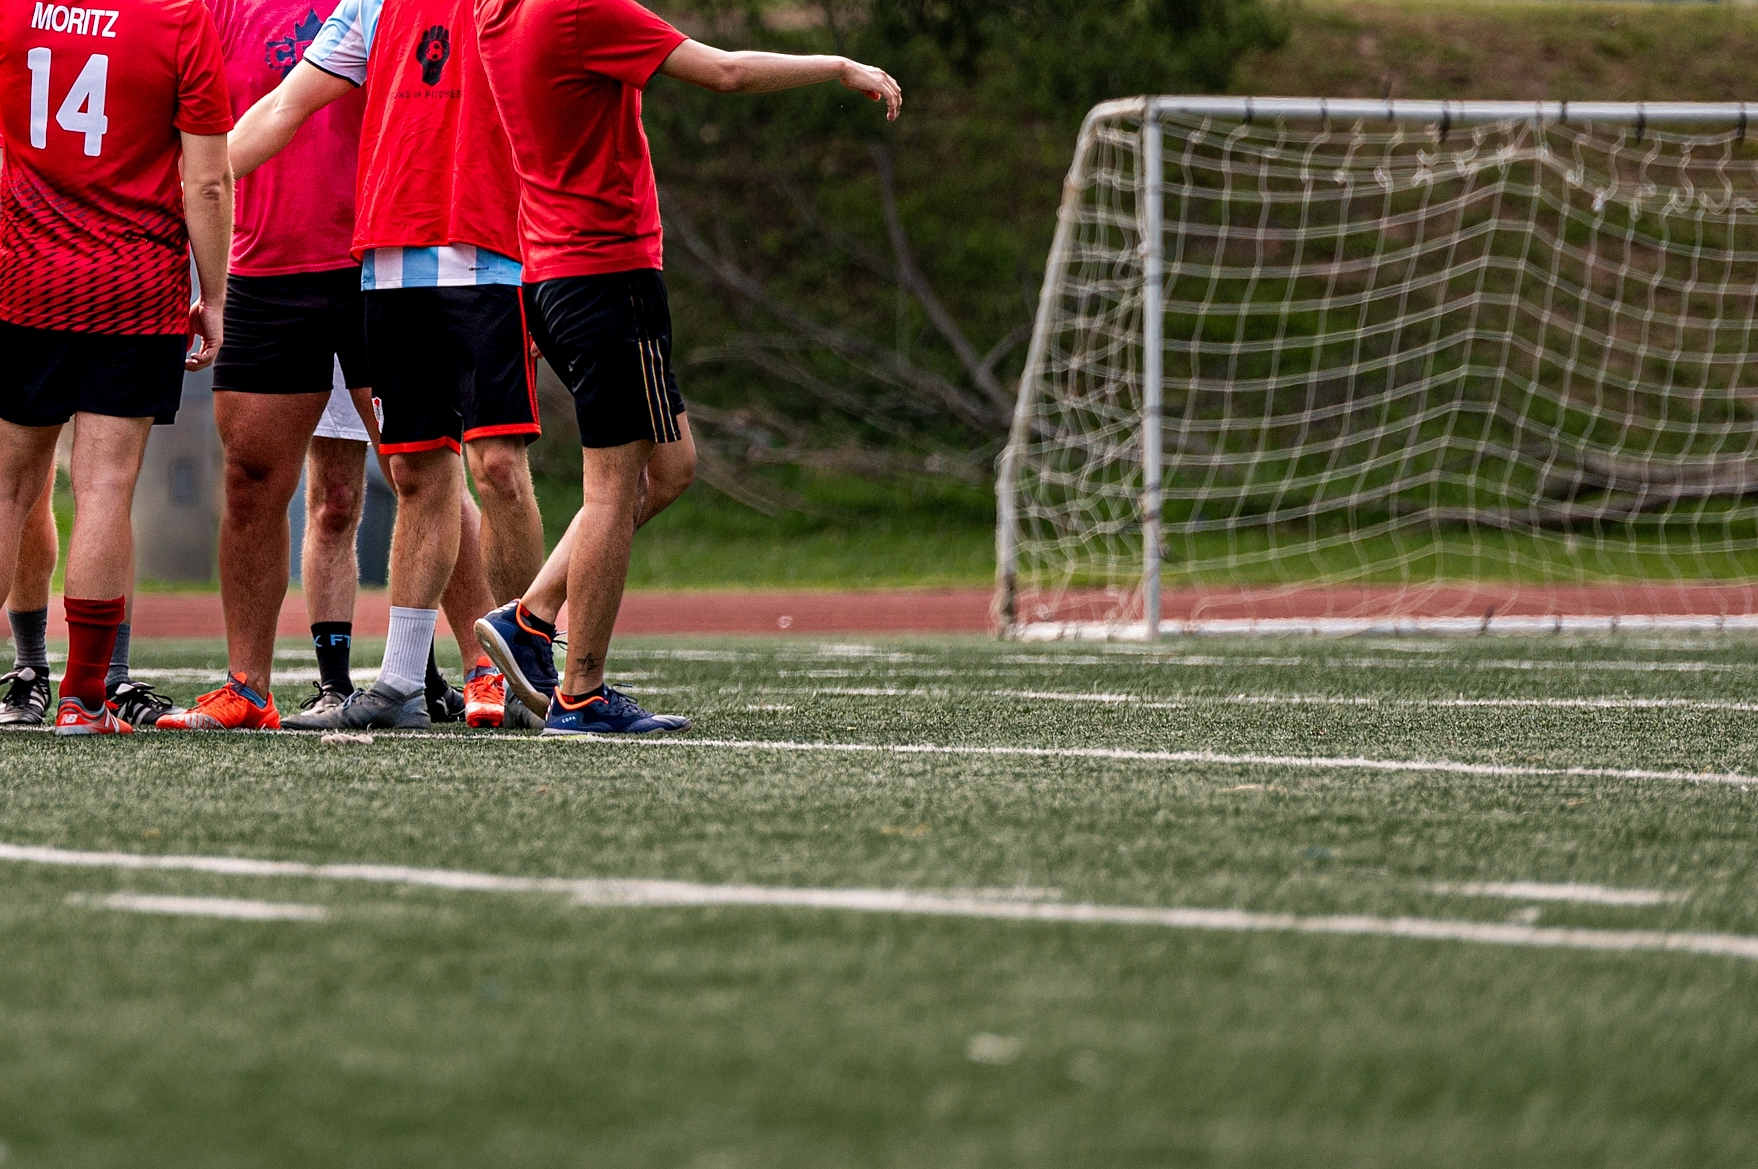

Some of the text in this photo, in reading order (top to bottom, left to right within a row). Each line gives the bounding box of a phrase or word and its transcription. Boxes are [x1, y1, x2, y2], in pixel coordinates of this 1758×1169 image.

[30, 1, 120, 38] MORITZ
[27, 46, 109, 157] 14
[60, 713, 78, 725] NB
